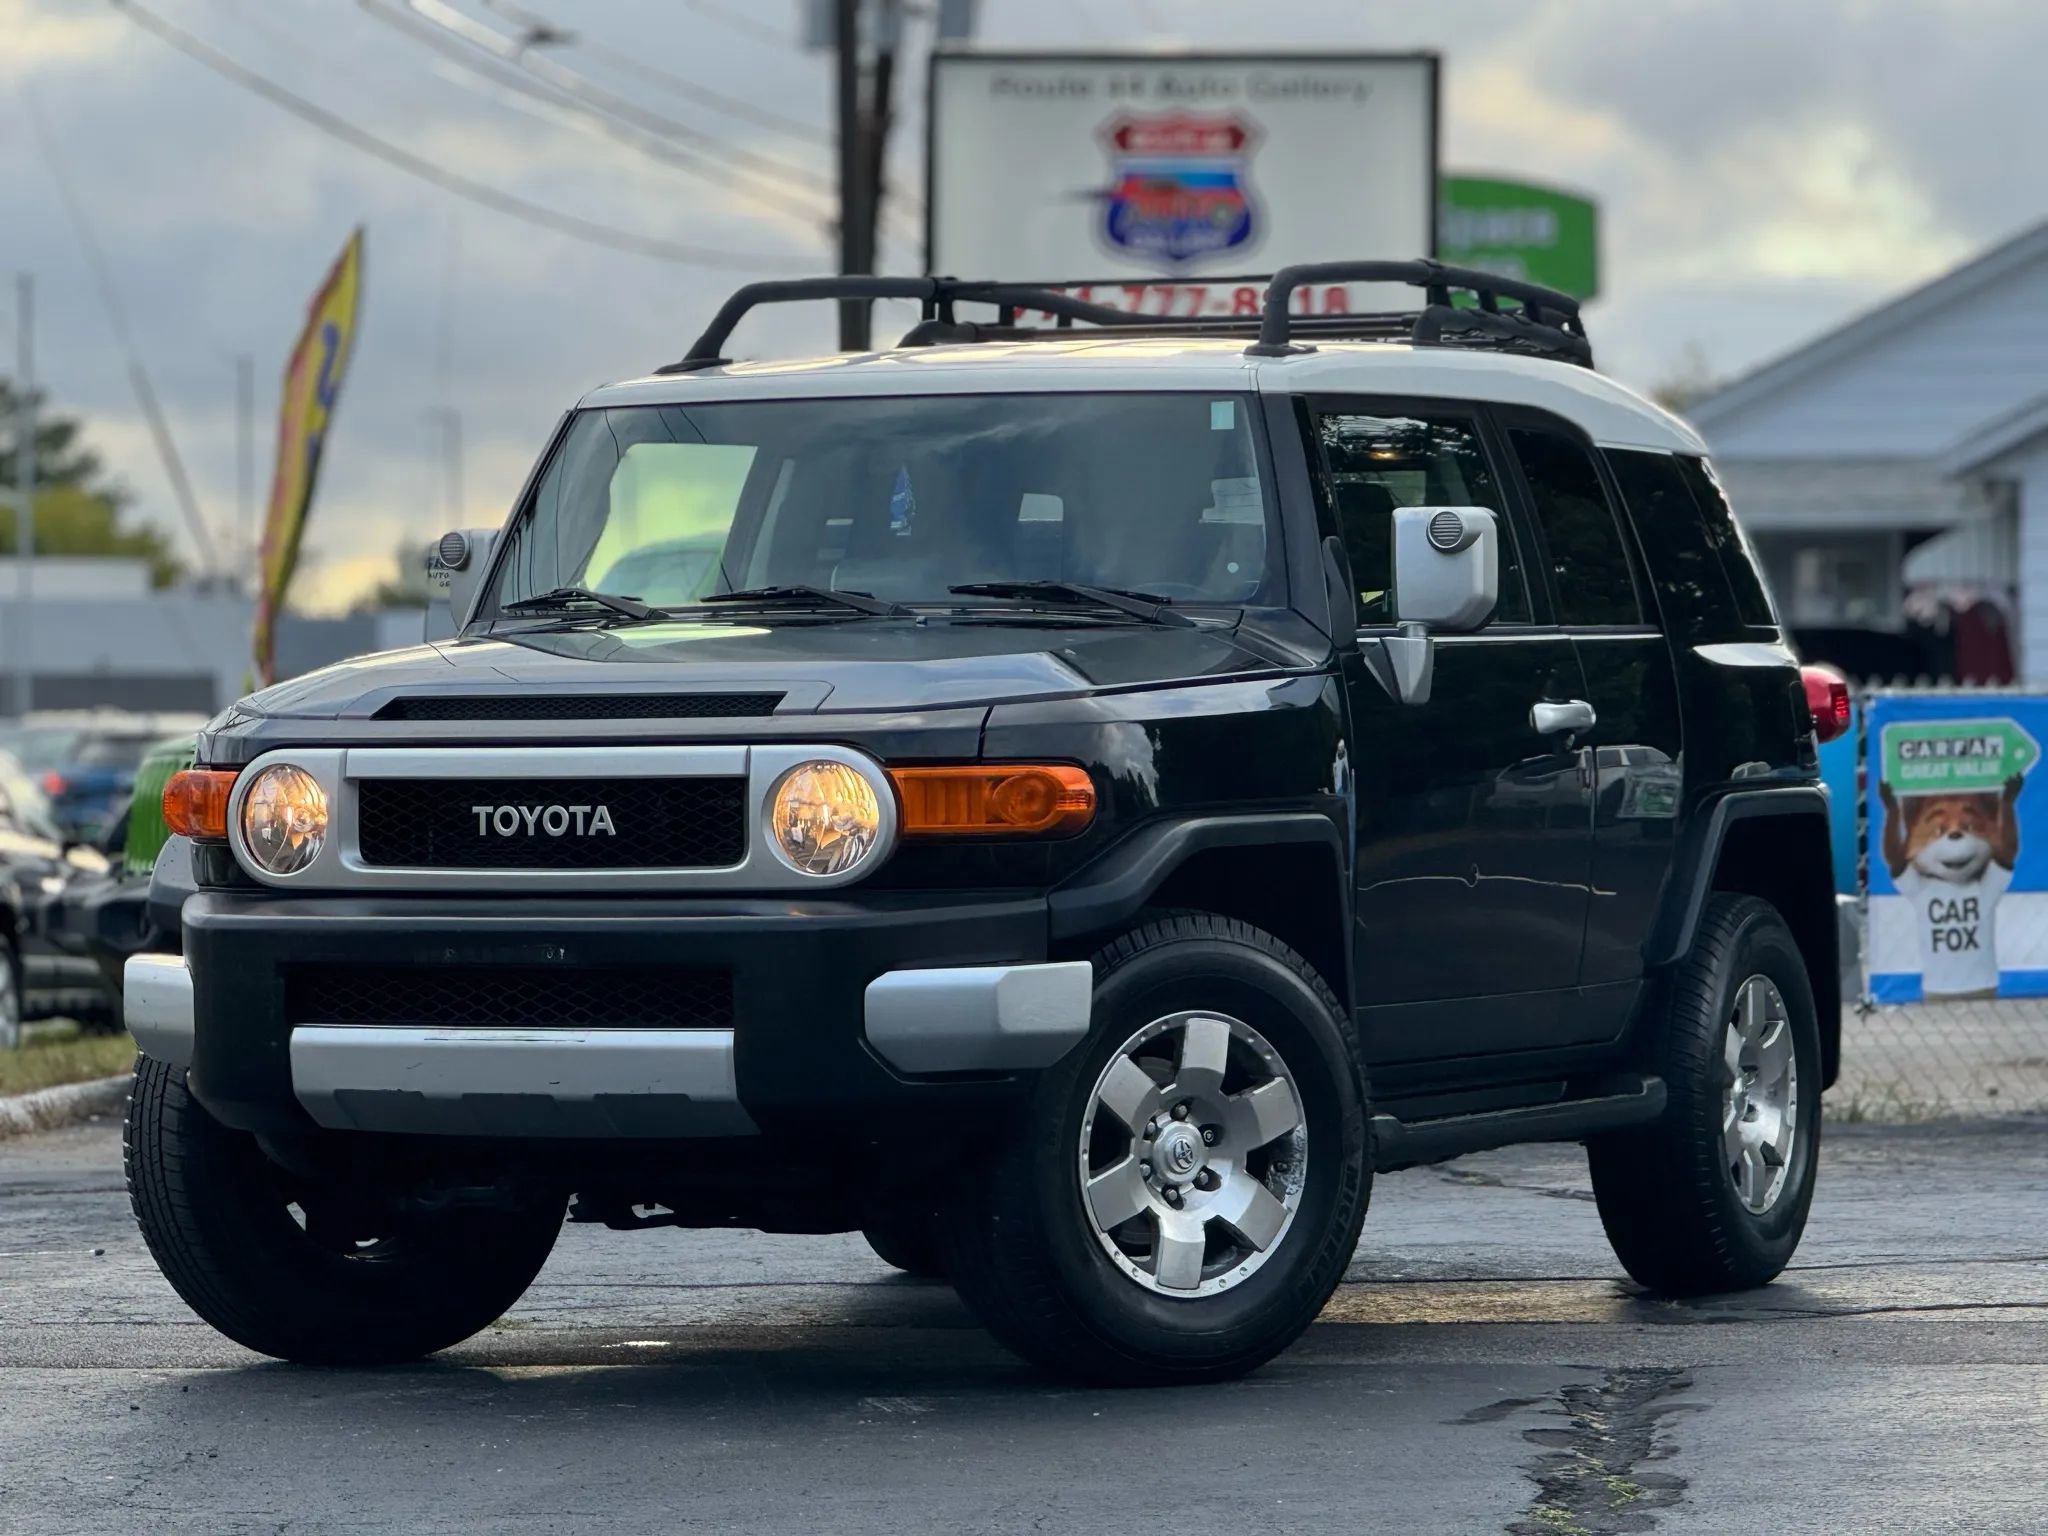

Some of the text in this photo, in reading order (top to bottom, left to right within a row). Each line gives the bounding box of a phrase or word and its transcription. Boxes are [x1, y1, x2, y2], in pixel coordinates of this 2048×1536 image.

[989, 73, 1091, 97] Route
[1154, 73, 1235, 97] Auto
[1899, 737, 2003, 759] CARFAX
[1901, 762, 1949, 779] GREAT
[472, 805, 616, 837] TOYOTA
[1928, 897, 1979, 924] CAR
[1932, 925, 1980, 953] FOX
